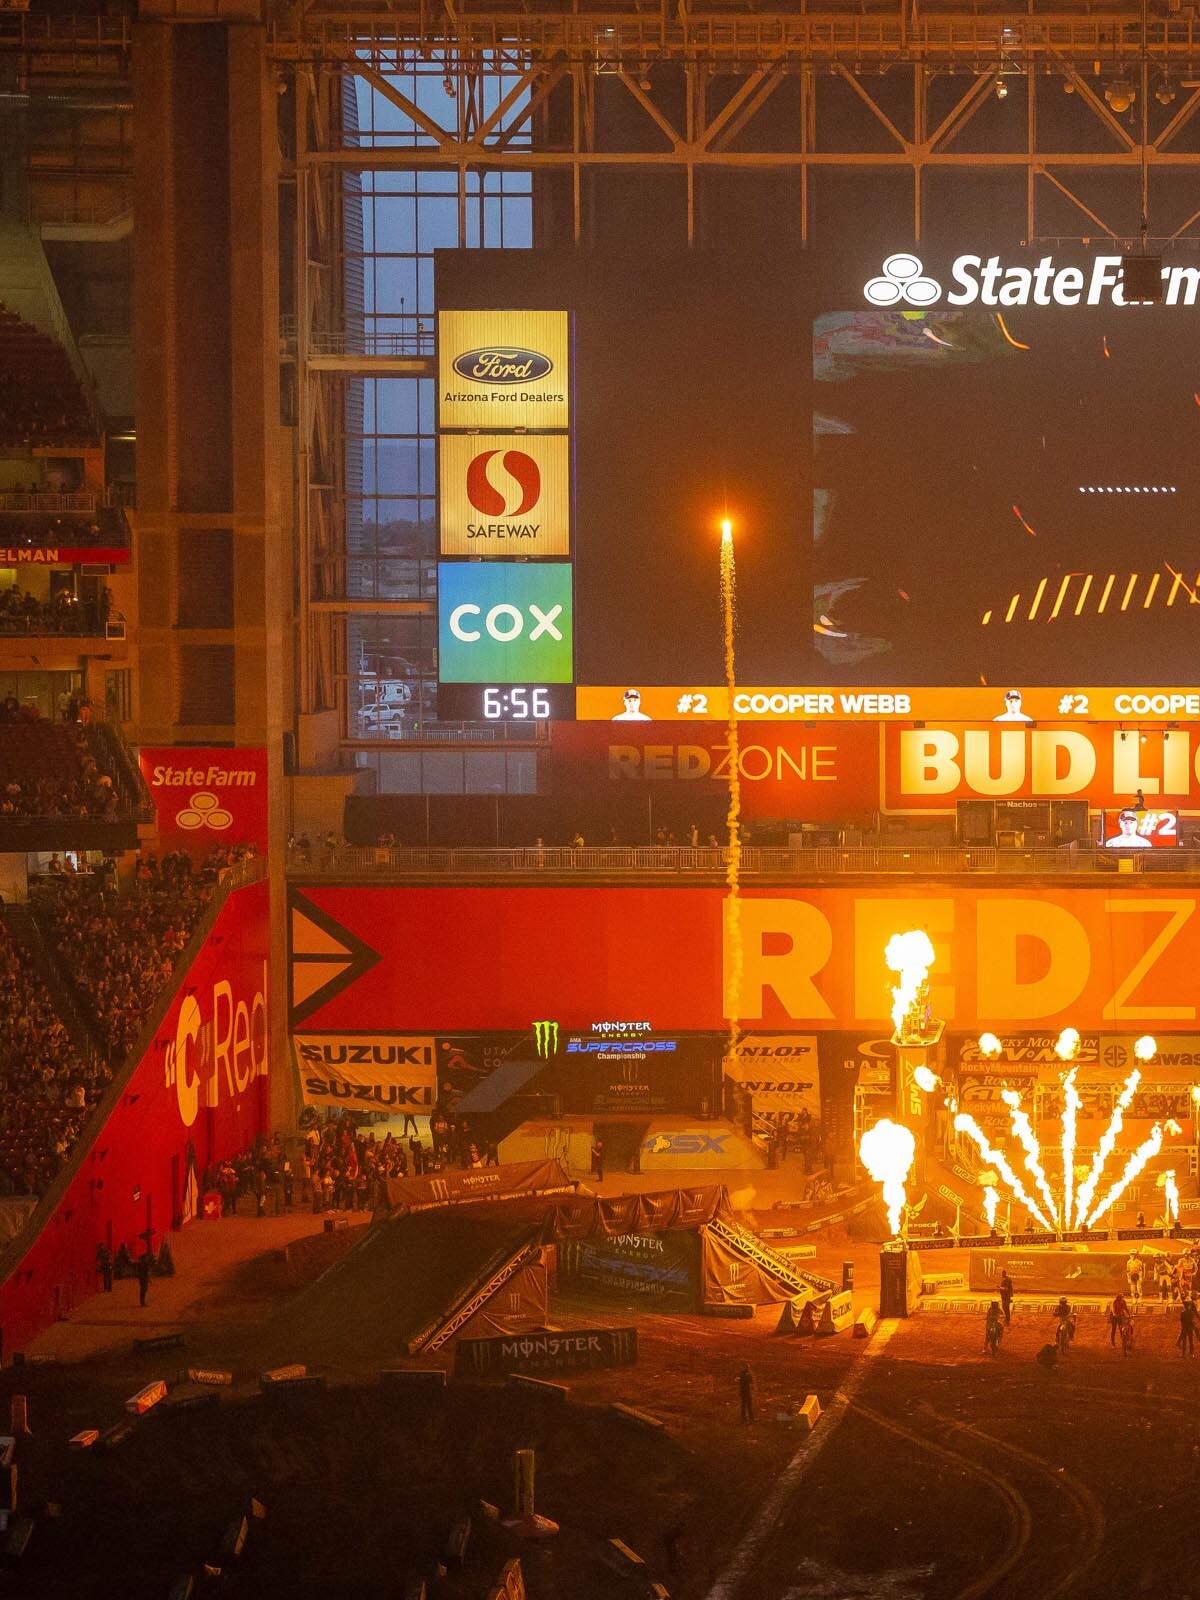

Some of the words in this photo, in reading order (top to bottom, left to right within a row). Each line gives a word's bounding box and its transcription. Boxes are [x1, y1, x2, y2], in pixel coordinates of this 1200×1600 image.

[472, 351, 531, 379] Ford
[444, 392, 488, 402] Arizona
[491, 392, 516, 402] Ford
[520, 392, 564, 402] Dealers
[466, 524, 540, 539] SAFEWAY
[449, 604, 563, 641] COX
[483, 688, 550, 718] 6:56
[677, 694, 707, 714] #2
[734, 694, 834, 714] COOPER
[840, 694, 911, 714] WEBB
[1058, 694, 1088, 714] #2
[609, 745, 838, 781] REDZONE
[900, 730, 1095, 796] BUD
[1139, 813, 1176, 836] #2
[206, 960, 268, 1107] Red
[592, 1021, 652, 1032] MONSTER
[300, 1045, 432, 1065] SUZUKI
[566, 1041, 677, 1052] SUPERCROSS
[597, 1052, 646, 1060] Championship
[305, 1078, 432, 1105] SUZUKI
[501, 1336, 602, 1358] MONSTER
